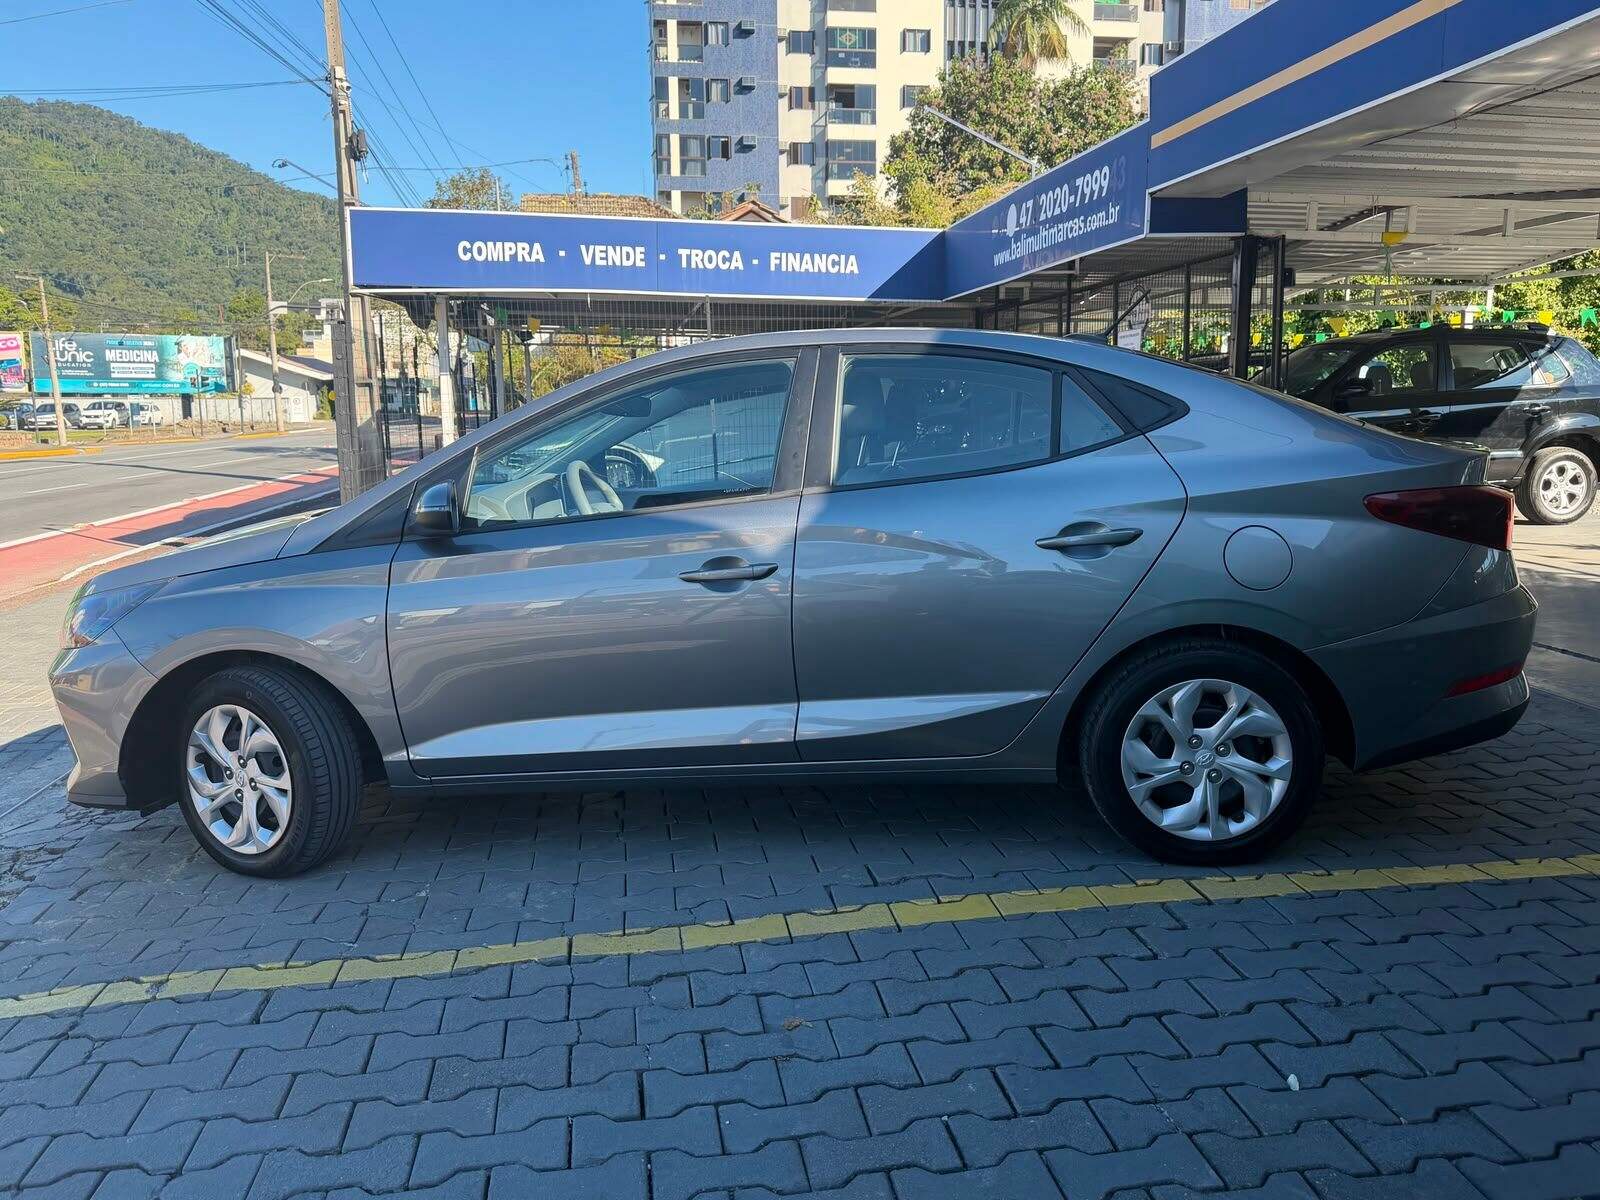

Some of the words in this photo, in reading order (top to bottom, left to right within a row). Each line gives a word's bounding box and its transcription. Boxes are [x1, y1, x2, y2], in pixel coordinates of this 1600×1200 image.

[1039, 165, 1110, 222] 2020-7999
[457, 240, 545, 263] COMPRA
[580, 244, 646, 267] VENDE
[678, 248, 744, 271] TROCA
[769, 252, 859, 275] FINANCIA
[993, 201, 1120, 268] www.balimultimarcas.com.br
[105, 349, 159, 363] MEDICINA
